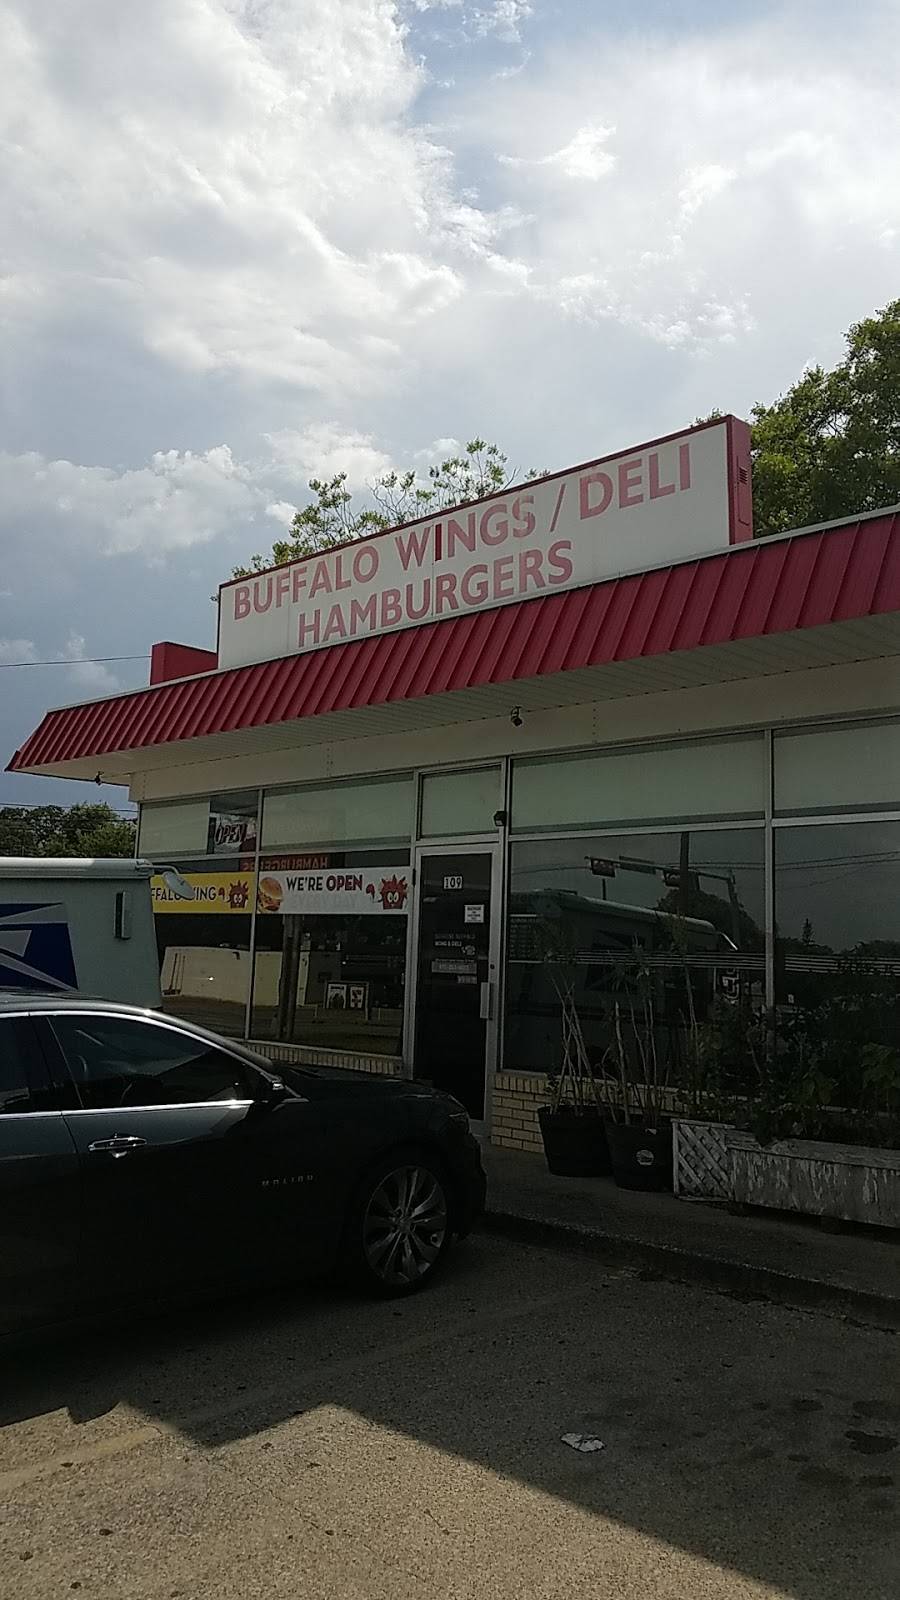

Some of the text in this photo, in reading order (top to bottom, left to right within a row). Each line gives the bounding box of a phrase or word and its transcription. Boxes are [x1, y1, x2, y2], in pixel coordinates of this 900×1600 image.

[234, 443, 691, 620] BUFFALO WINGS / DELI
[298, 540, 573, 648] HAMBURGERS
[215, 823, 248, 845] OPEN
[286, 874, 363, 892] WE'RE OPEN
[445, 877, 462, 888] 109
